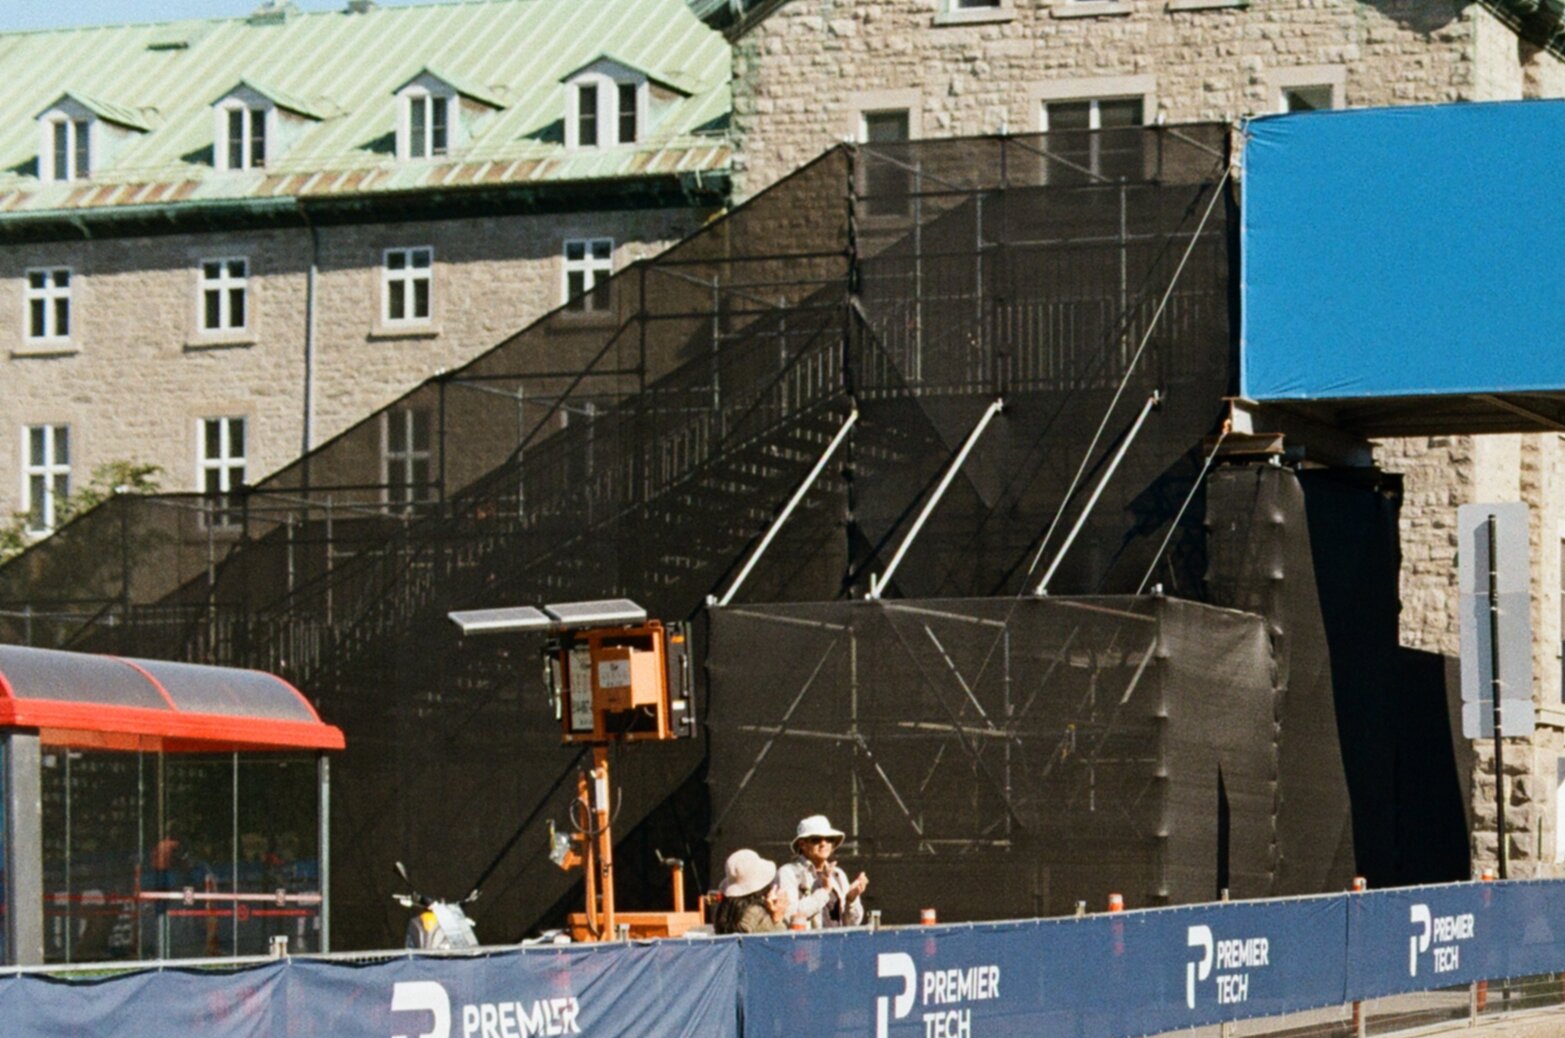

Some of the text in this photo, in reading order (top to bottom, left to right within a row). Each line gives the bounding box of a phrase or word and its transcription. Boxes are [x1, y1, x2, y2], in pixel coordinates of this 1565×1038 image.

[1434, 913, 1474, 943] PREMIER
[1216, 938, 1269, 969] PREMIER
[1434, 945, 1459, 973] TECH
[923, 965, 1000, 1005] PREMIER
[1216, 973, 1249, 1004] TECH
